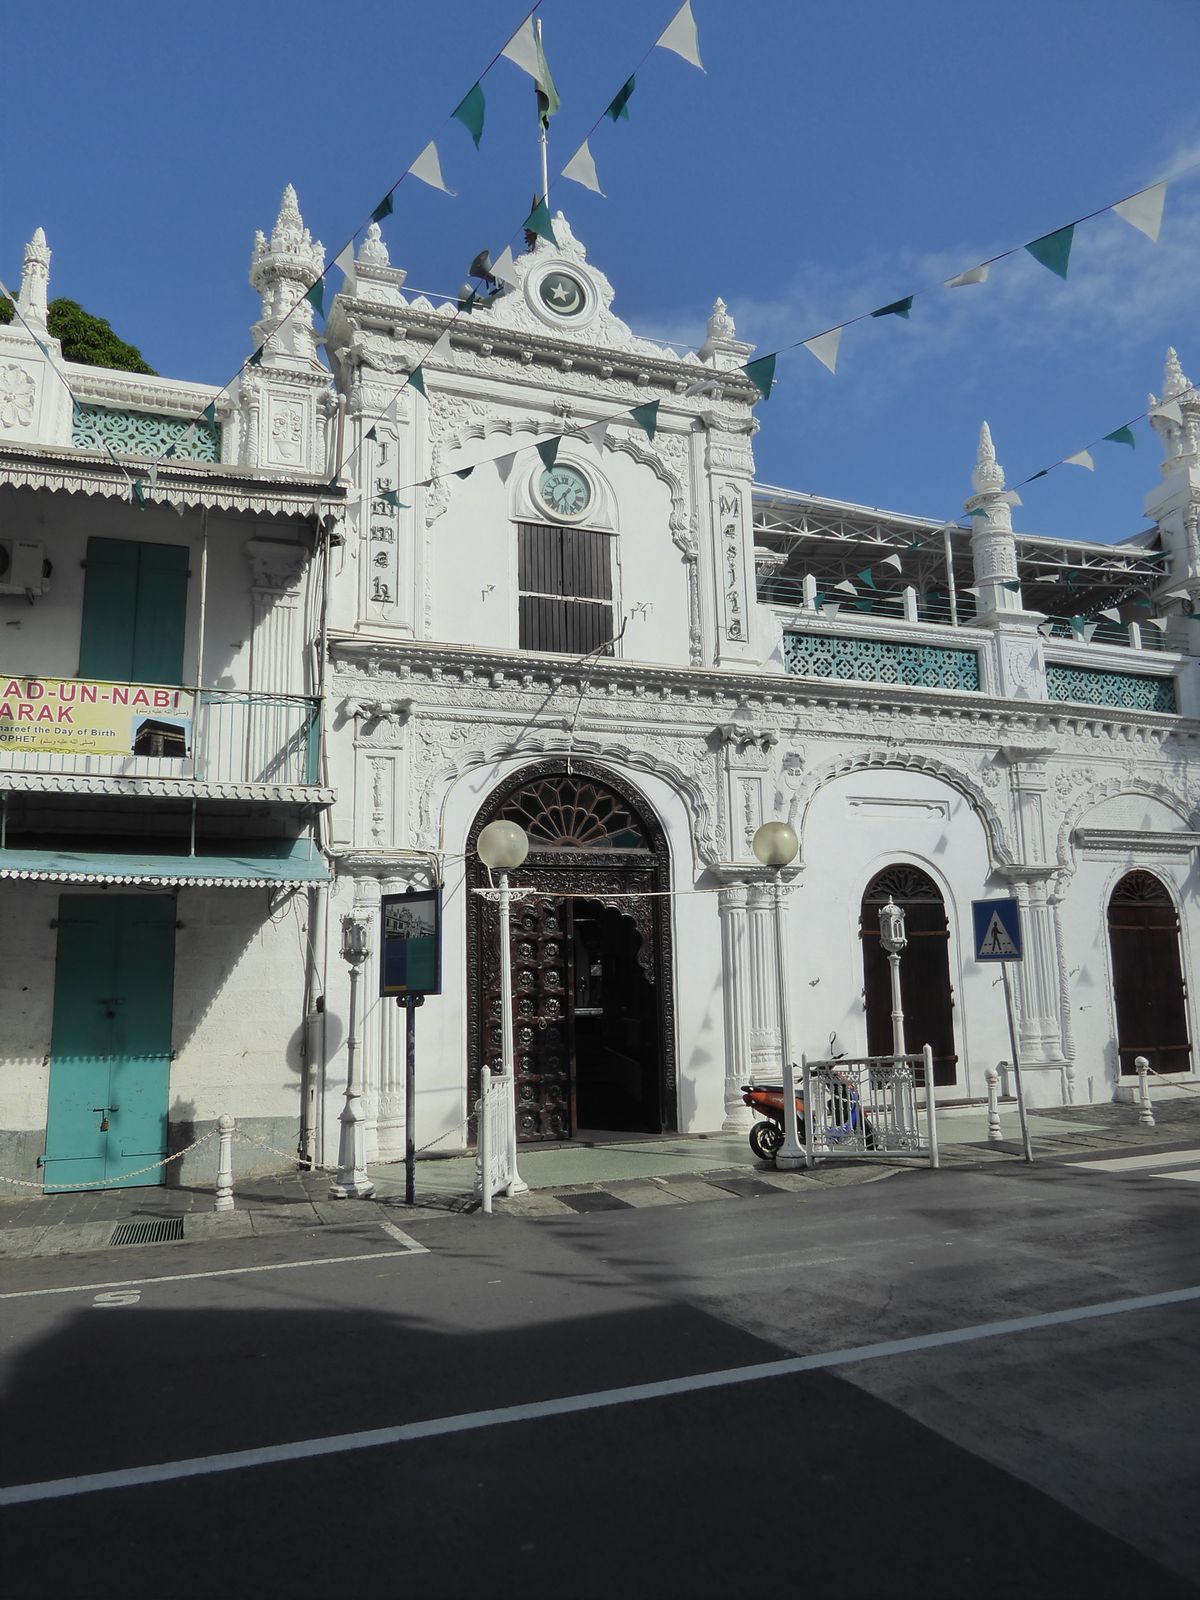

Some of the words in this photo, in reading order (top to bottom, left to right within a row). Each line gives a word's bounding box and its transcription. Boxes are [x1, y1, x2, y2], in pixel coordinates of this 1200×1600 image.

[0, 702, 74, 723] ARAK
[35, 726, 50, 734] the
[54, 727, 73, 736] Day
[91, 729, 115, 737] Birth
